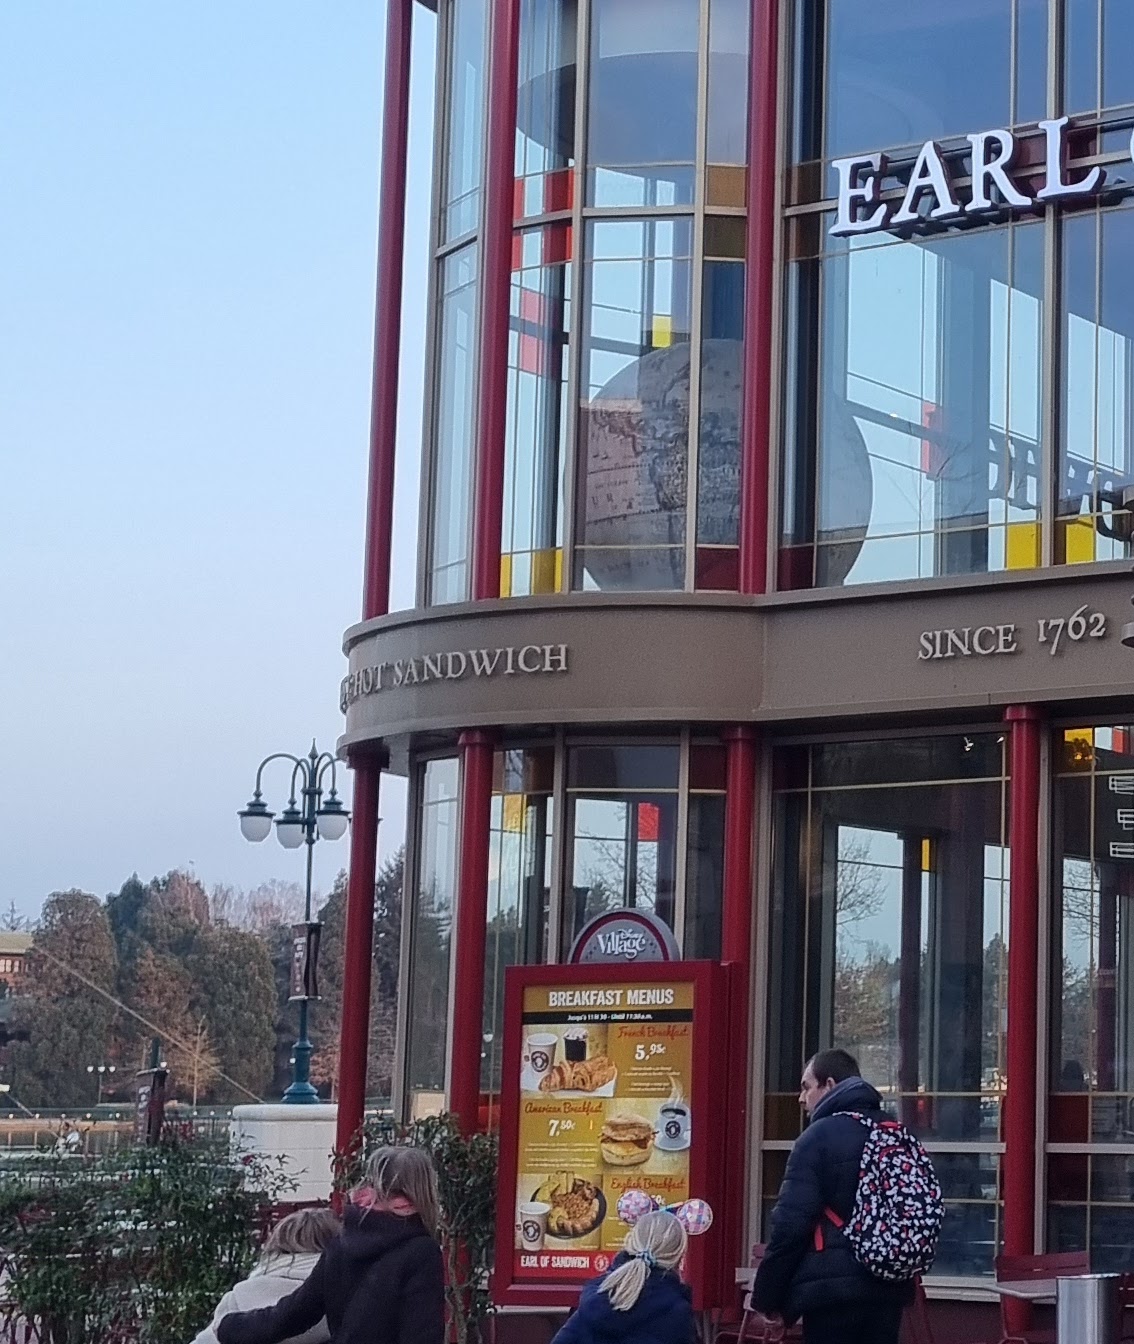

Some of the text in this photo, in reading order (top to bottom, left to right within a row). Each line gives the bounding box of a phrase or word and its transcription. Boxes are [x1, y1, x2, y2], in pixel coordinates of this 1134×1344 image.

[828, 115, 1100, 238] EARL
[917, 604, 1106, 660] SINCE 1762
[354, 662, 387, 696] HOT
[393, 644, 568, 686] SANDWICH
[597, 932, 646, 959] Village
[549, 988, 674, 1006] BREAKFAST MENUS
[525, 1101, 603, 1115] American Breakfast
[611, 1177, 686, 1193] English Breakfast
[521, 1256, 590, 1268] EARL OF SANDWICH
